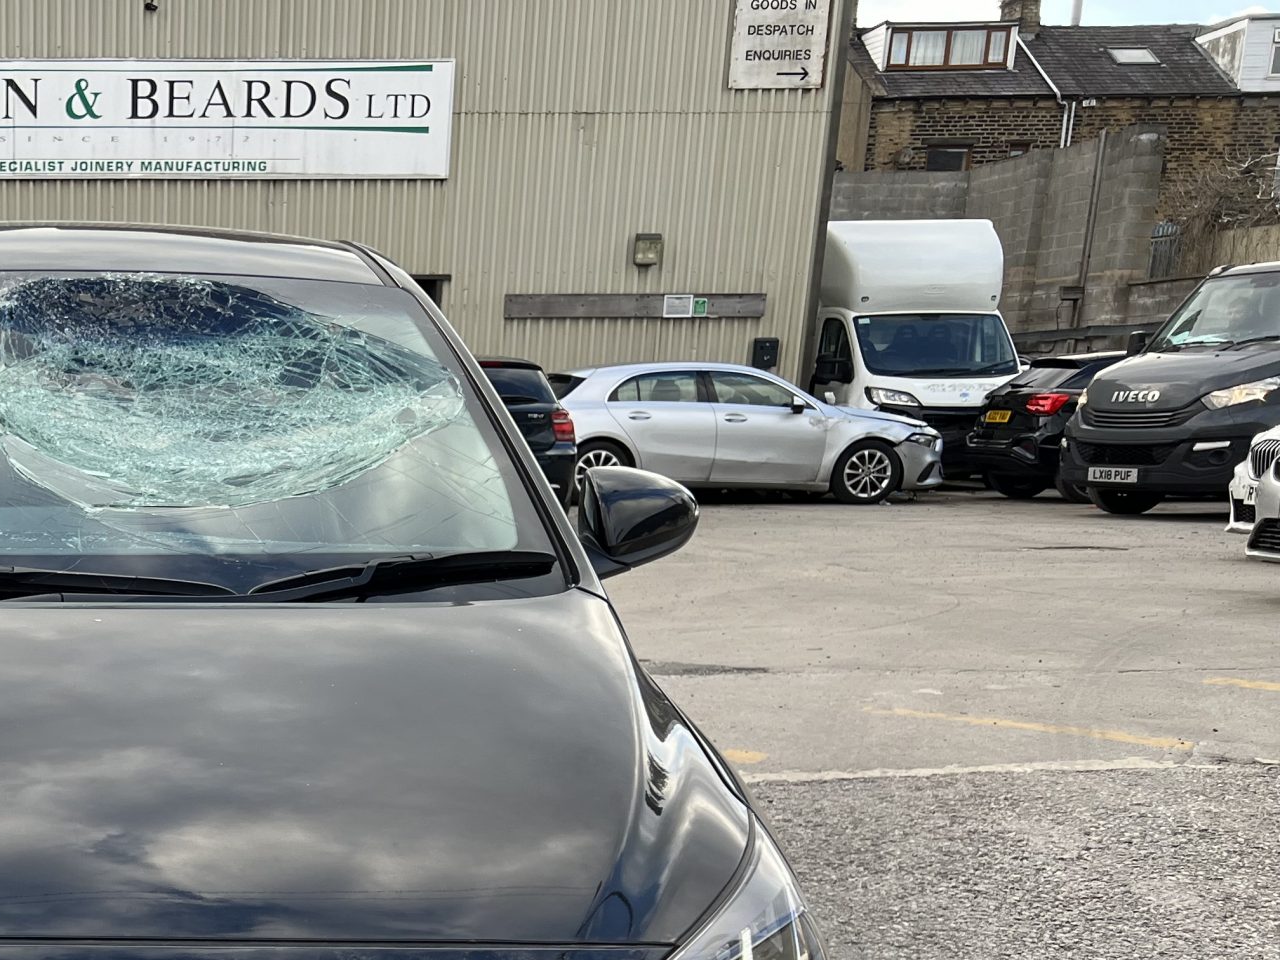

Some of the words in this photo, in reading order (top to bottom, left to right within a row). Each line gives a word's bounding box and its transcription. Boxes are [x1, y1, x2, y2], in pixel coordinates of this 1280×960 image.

[750, 0, 797, 10] GOODS
[805, 0, 817, 10] IN
[747, 24, 815, 36] DESPATCH
[745, 49, 812, 61] ENQUIRIES
[65, 78, 103, 120] &
[126, 77, 352, 121] BEARDS
[365, 93, 432, 119] LTD
[70, 161, 134, 172] JOINERY
[140, 161, 269, 172] MANUFACTURING
[1111, 390, 1160, 403] IVECO
[1092, 470, 1112, 480] LX18
[1113, 470, 1133, 481] PUF
